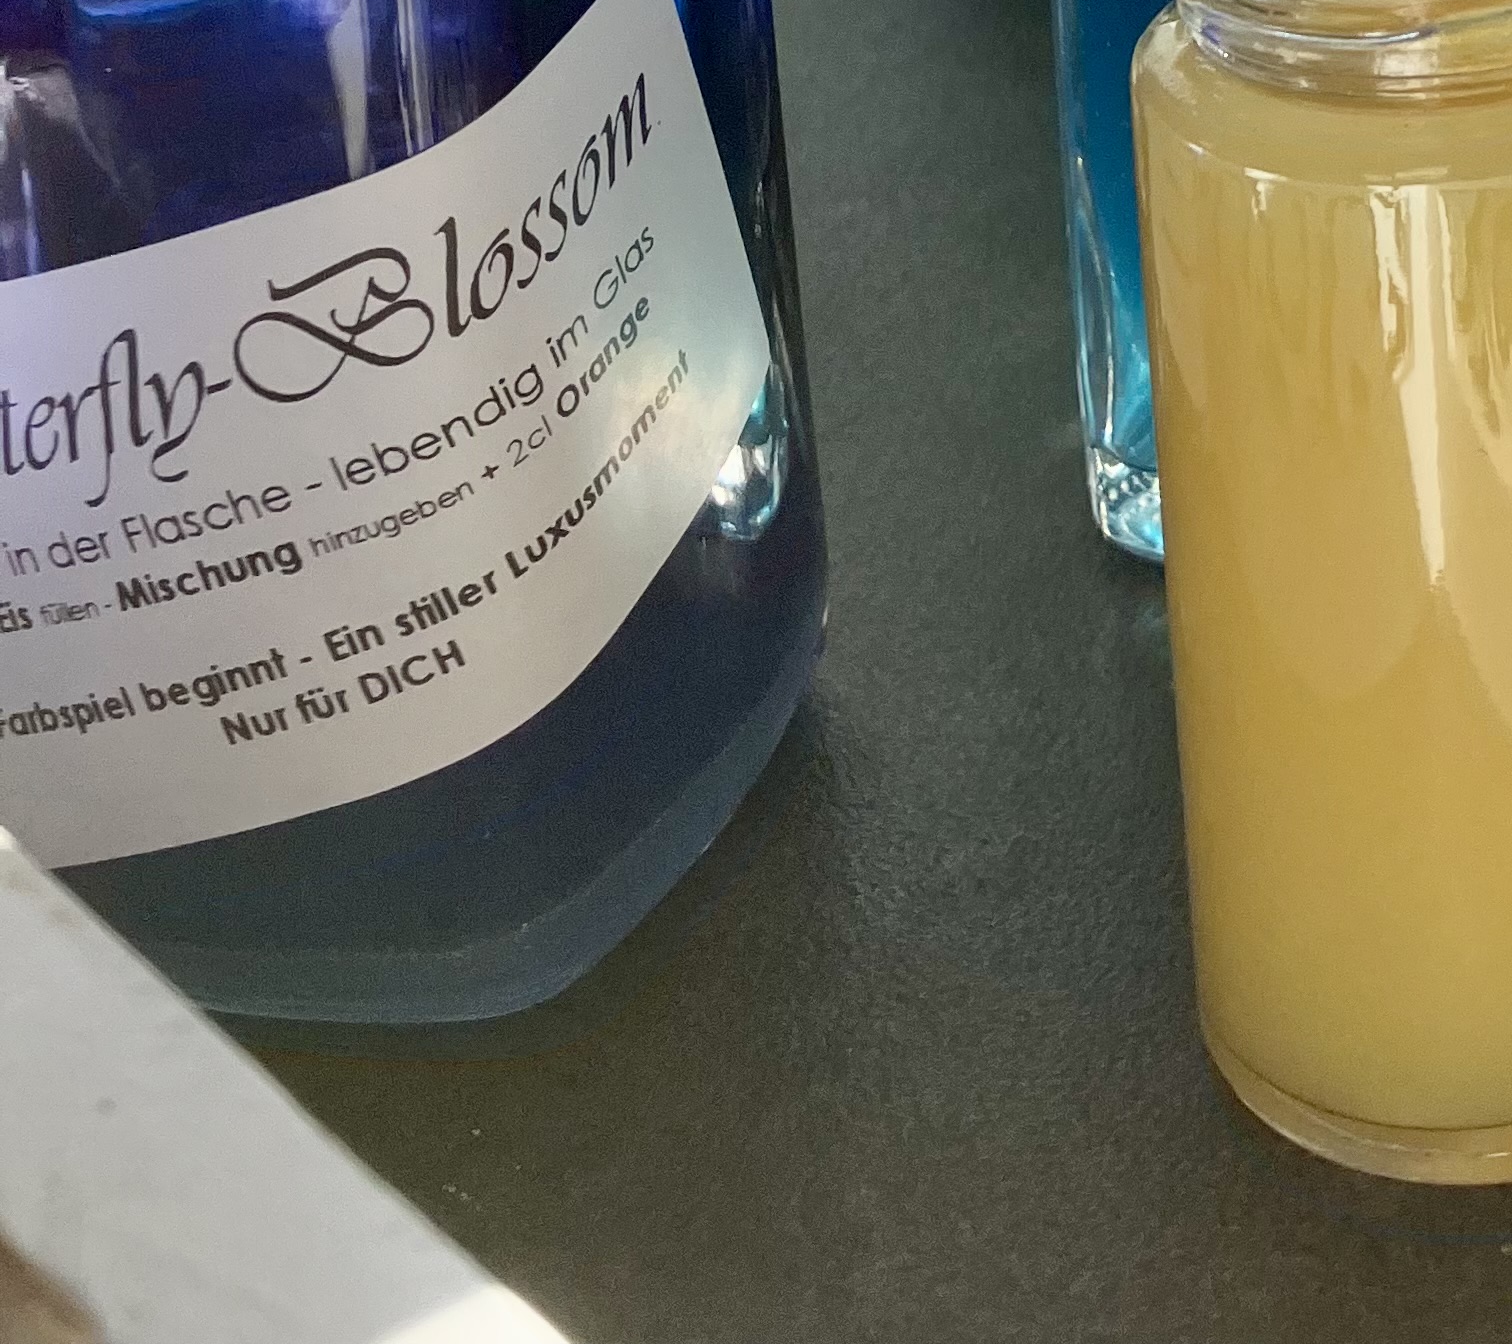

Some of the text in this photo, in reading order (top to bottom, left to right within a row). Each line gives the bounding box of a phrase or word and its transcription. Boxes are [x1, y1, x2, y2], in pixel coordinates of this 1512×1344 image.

[3, 541, 40, 577] in
[48, 511, 111, 568] der
[121, 489, 292, 553] Flasche
[330, 363, 545, 491] lebendig
[546, 314, 589, 368] im
[593, 226, 654, 309] Glas
[116, 541, 303, 611] Mischung
[308, 480, 474, 558] hinzugeben
[506, 414, 554, 468] 2cl
[556, 296, 650, 418] Orange
[0, 686, 136, 736] arbspiel
[139, 648, 288, 707] beginnt
[323, 624, 386, 663] Ein
[394, 570, 498, 637] stiller
[220, 639, 467, 745] Nur für DICH
